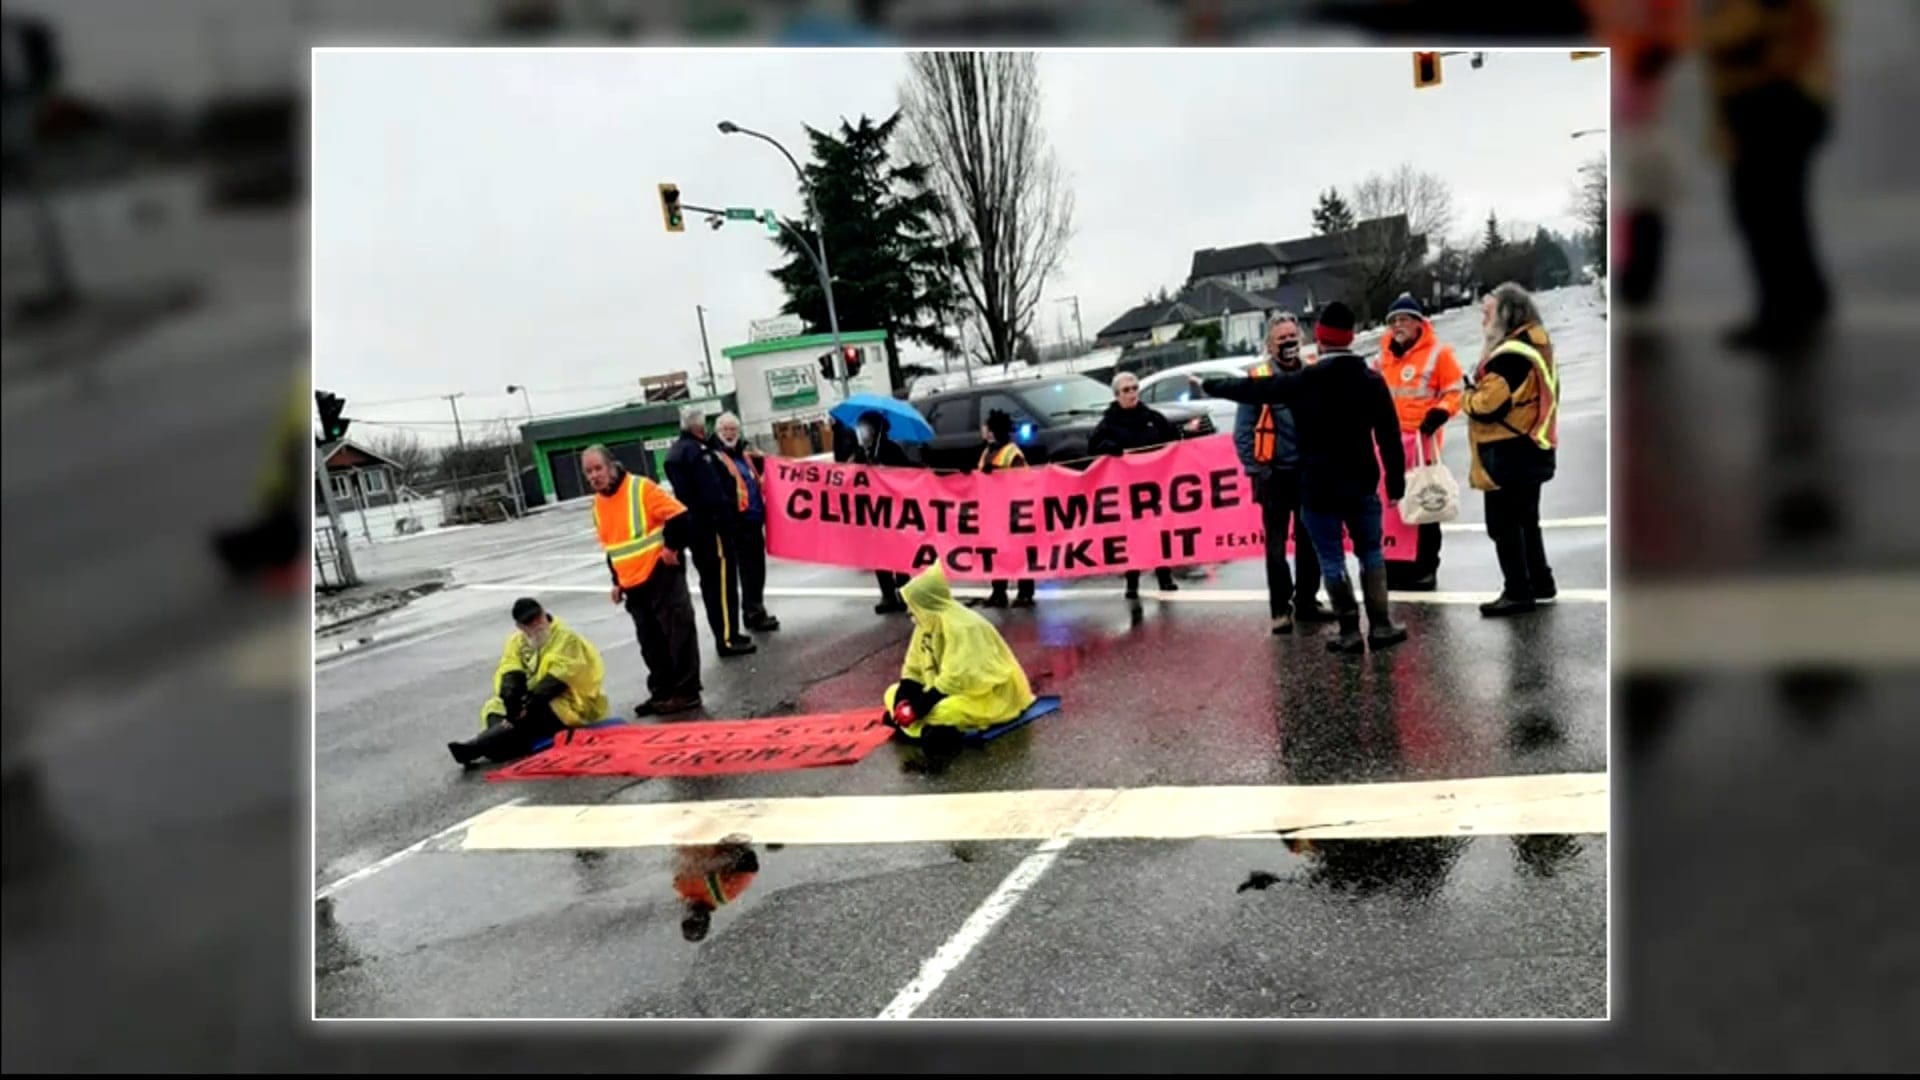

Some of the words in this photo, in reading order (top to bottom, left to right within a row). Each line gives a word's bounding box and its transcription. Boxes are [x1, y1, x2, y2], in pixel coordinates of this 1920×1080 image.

[778, 464, 820, 483] THS
[825, 469, 844, 486] IS
[853, 471, 870, 488] A
[786, 488, 980, 535] CLIMATE
[1009, 467, 1241, 535] EMERGE
[911, 544, 998, 573] ACT
[1026, 534, 1129, 573] LIKE
[1161, 526, 1202, 560] IT
[649, 743, 857, 766] GROWTH
